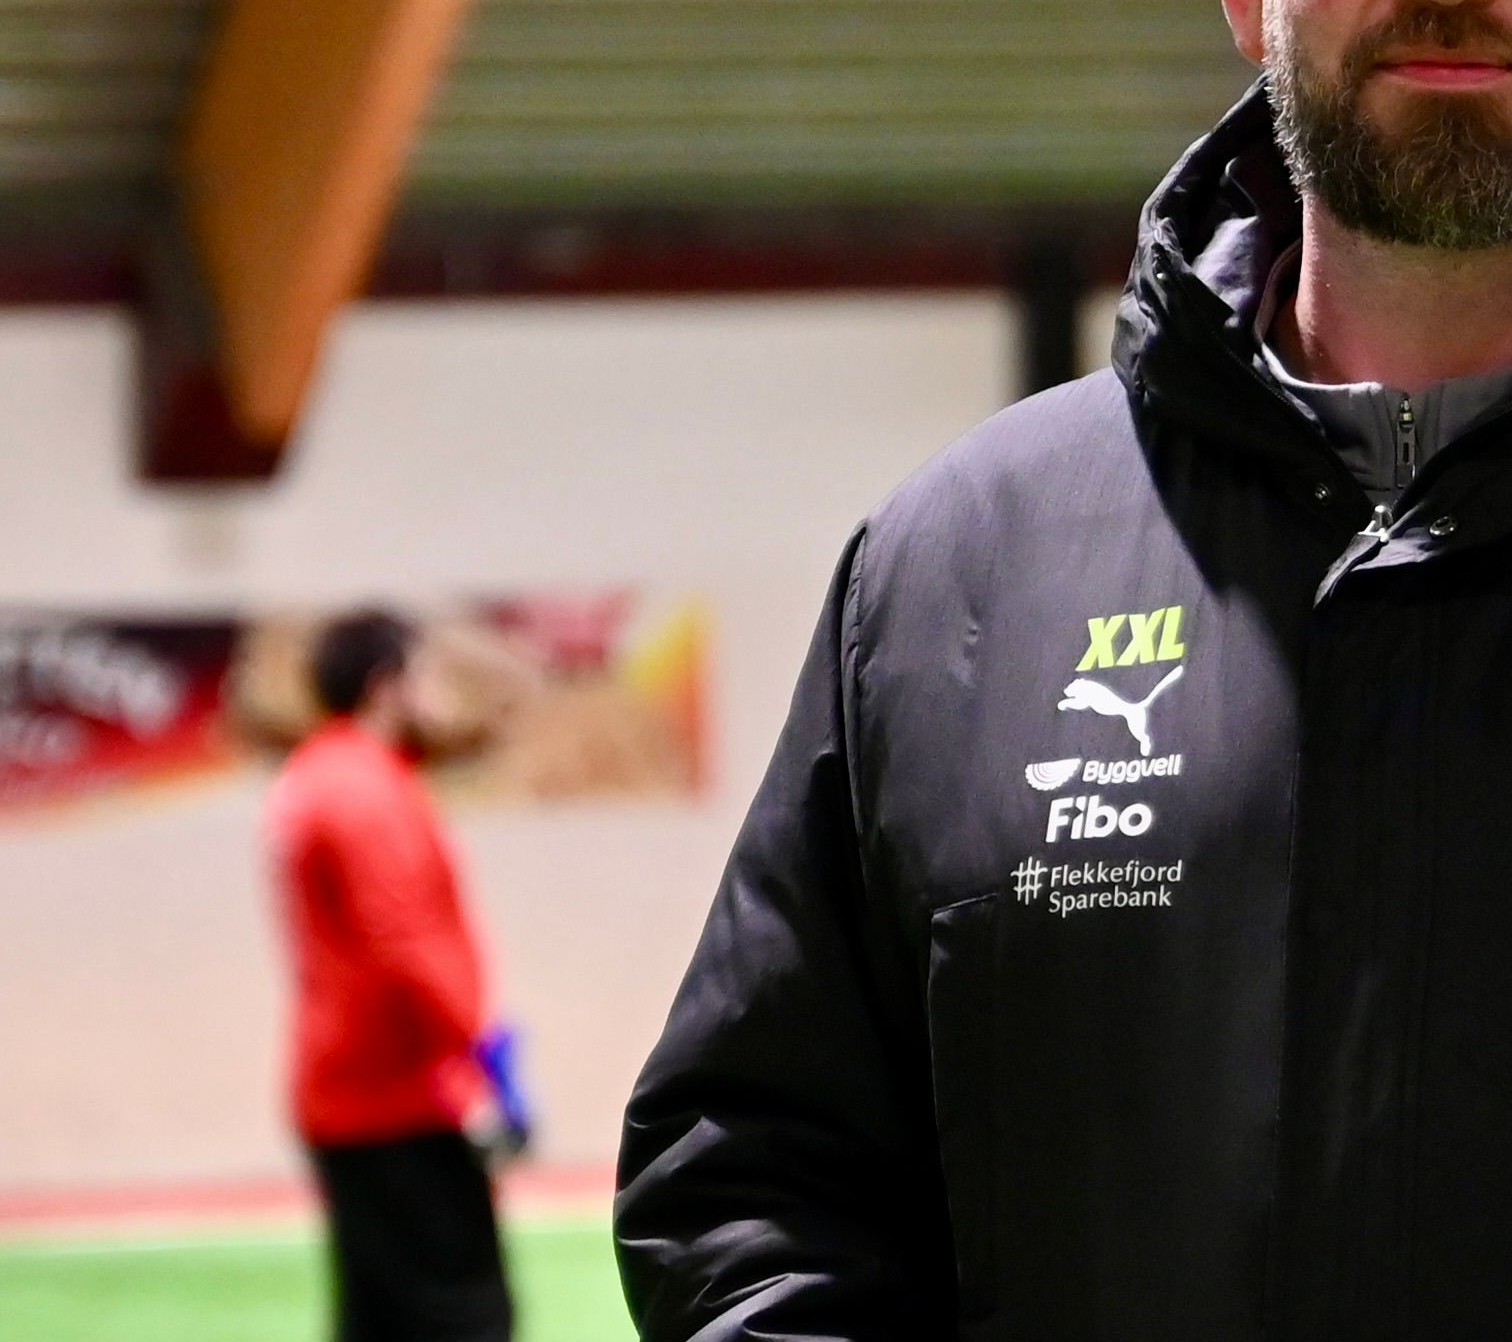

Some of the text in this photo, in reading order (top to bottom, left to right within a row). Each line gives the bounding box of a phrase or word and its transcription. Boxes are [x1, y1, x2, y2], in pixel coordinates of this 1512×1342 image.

[1075, 605, 1185, 672] XXL
[1082, 754, 1181, 785] Byggvell
[1045, 795, 1153, 843] Fibo
[1049, 860, 1182, 892] Flekkefjord
[1048, 886, 1172, 918] Sparebank
